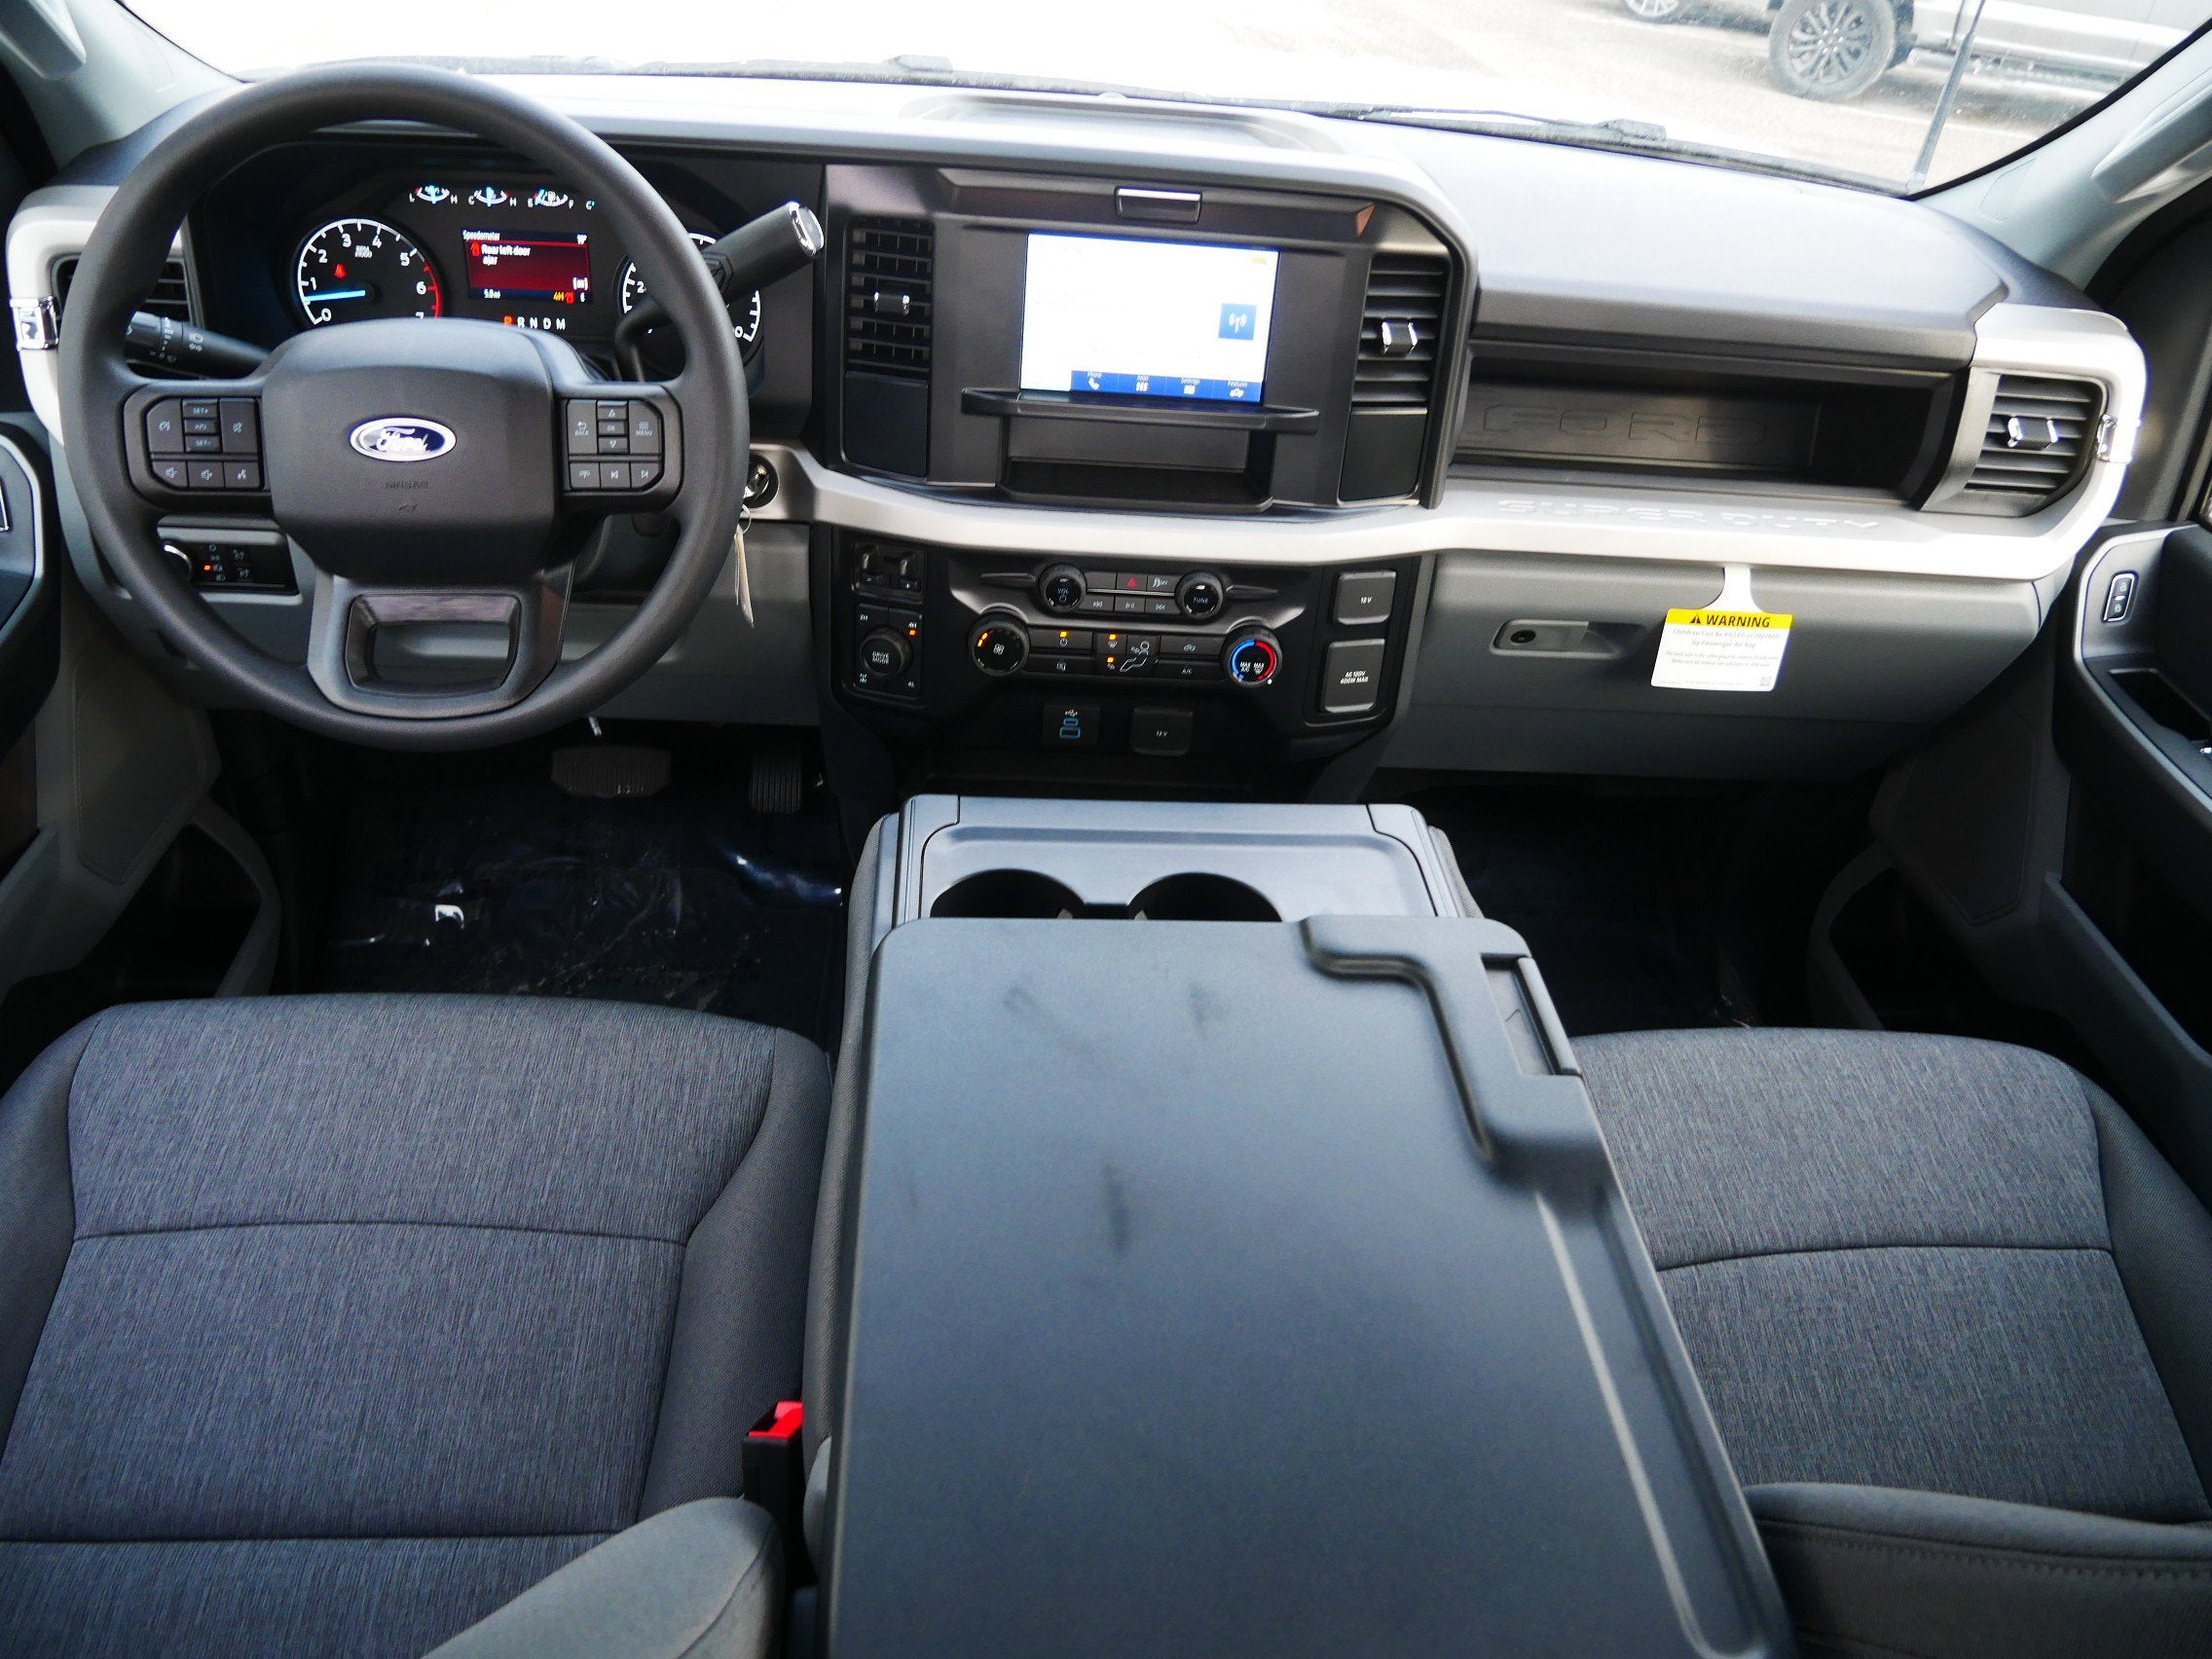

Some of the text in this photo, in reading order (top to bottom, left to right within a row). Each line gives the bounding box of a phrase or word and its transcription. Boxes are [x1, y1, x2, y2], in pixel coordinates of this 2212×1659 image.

[342, 233, 351, 247] 3
[372, 234, 383, 248] 4
[463, 230, 500, 241] Speedometer
[318, 249, 328, 263] 2
[482, 243, 531, 257] Rear left door
[399, 252, 410, 267] 5
[483, 255, 498, 266] ajar
[311, 276, 317, 290] 1
[416, 281, 426, 295] 6
[321, 308, 331, 321] 0
[517, 316, 525, 328] R
[530, 317, 537, 328] N
[543, 317, 551, 330] D
[556, 317, 566, 330] M
[1482, 403, 1766, 445] FORD
[377, 426, 429, 453] Ford
[1497, 498, 1880, 532] SUPER DUTY
[1194, 596, 1208, 605] TUNE
[1706, 614, 1771, 628] WARNING
[1701, 640, 1732, 648] Passenger
